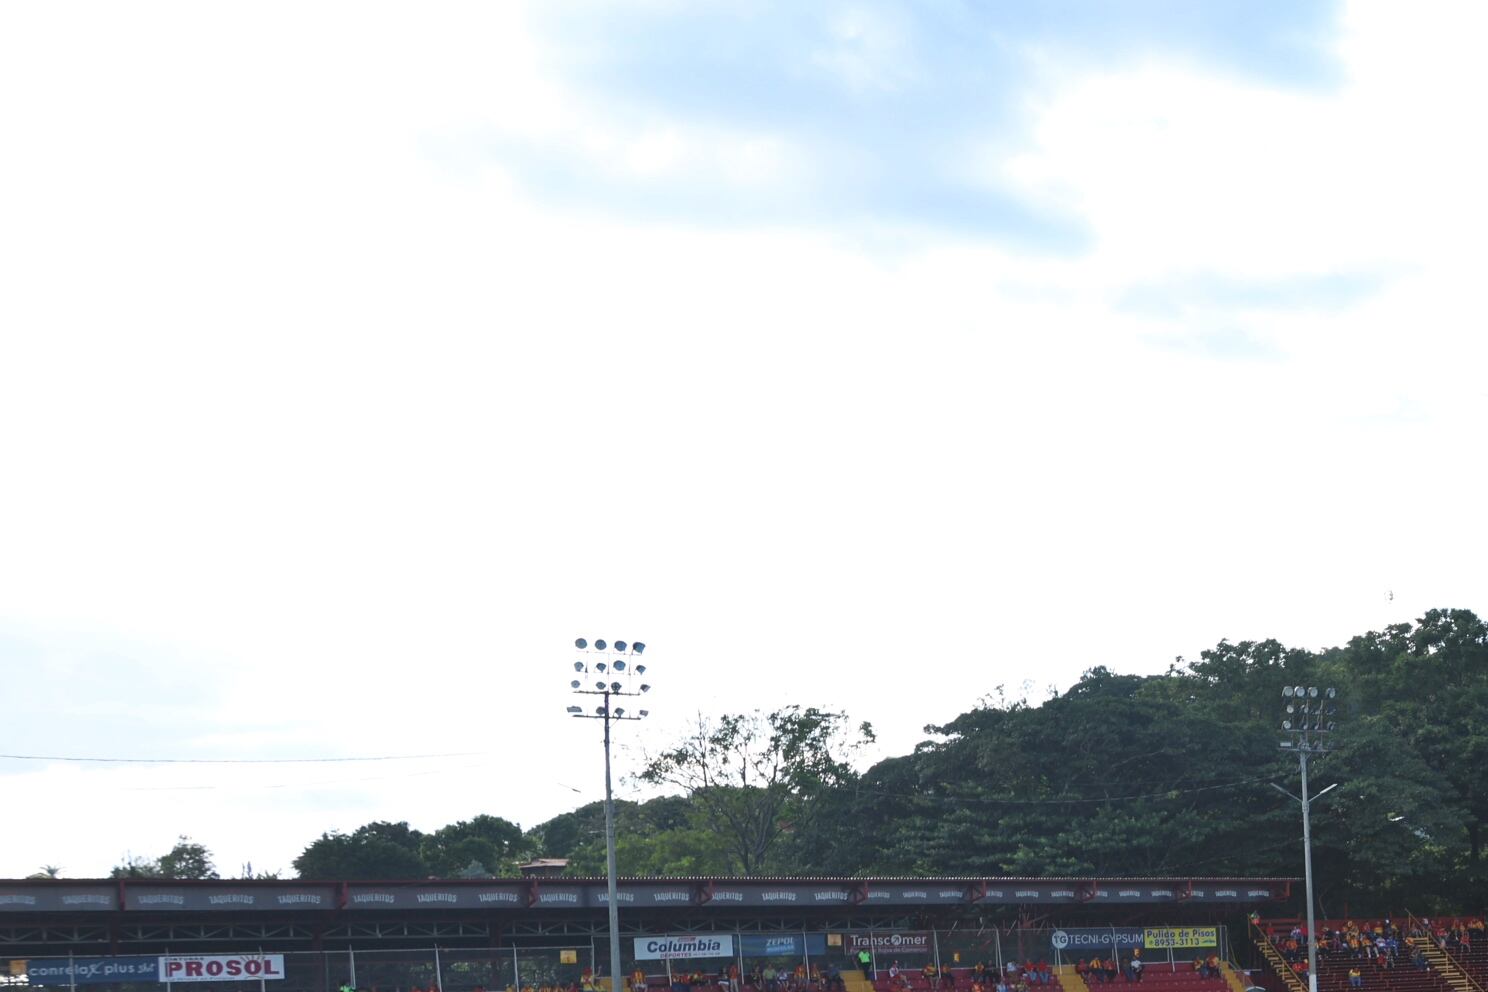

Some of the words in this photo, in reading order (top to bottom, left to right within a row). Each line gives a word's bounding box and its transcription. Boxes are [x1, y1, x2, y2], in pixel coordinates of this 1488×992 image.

[1179, 930, 1189, 938] de
[647, 939, 721, 953] Columbia
[165, 960, 280, 978] PROSOL
